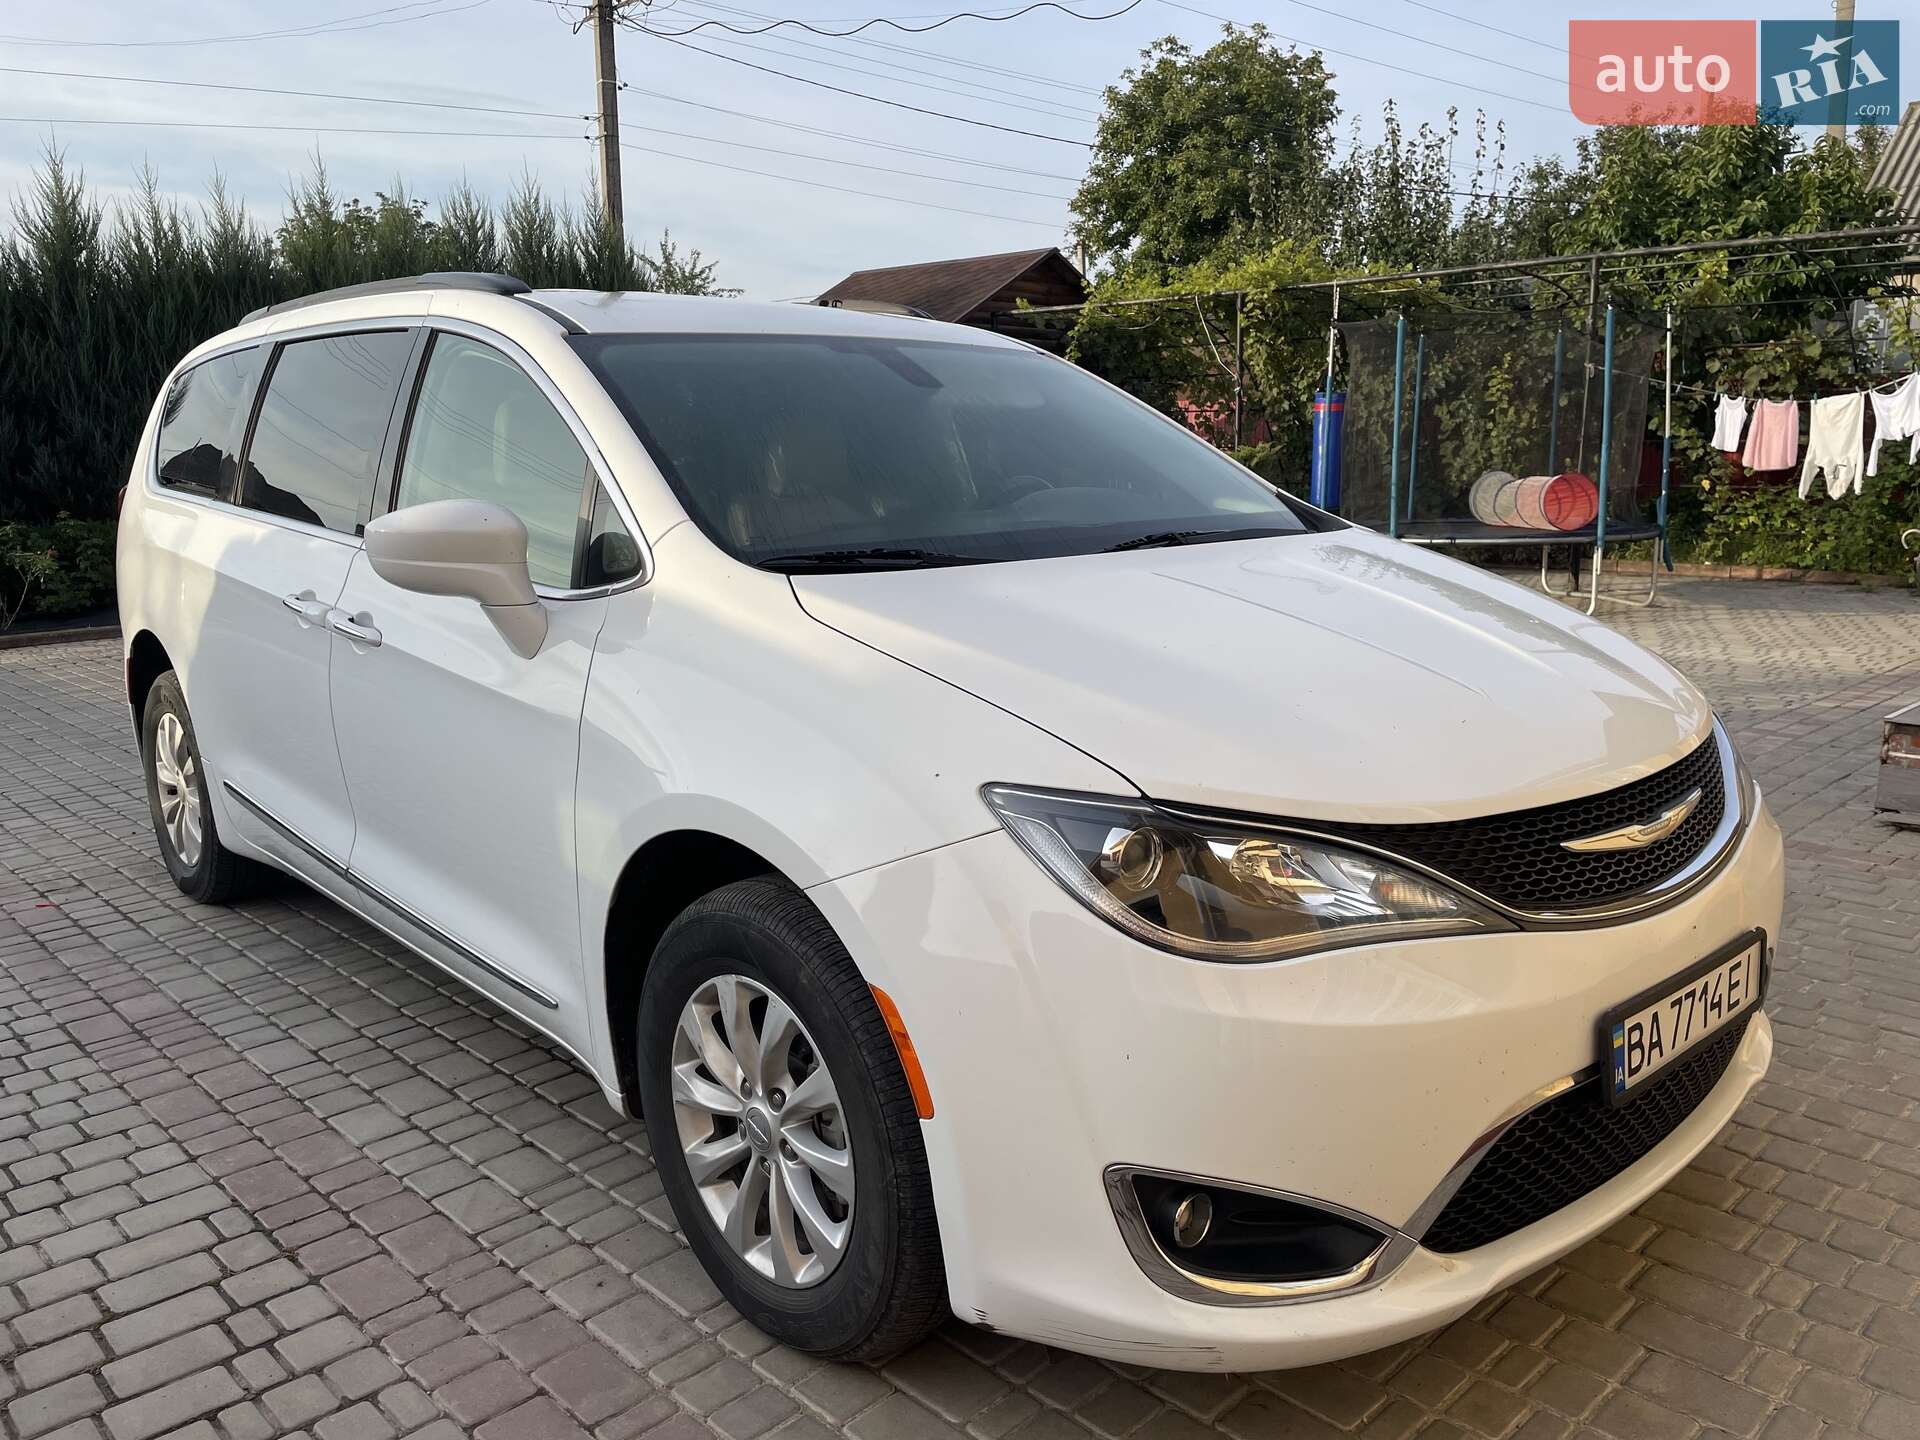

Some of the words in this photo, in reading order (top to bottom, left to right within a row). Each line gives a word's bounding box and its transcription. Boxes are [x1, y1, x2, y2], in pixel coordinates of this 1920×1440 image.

[1627, 1010, 1664, 1079] BA
[1670, 972, 1722, 1050] 7714
[1727, 953, 1751, 1013] EI
